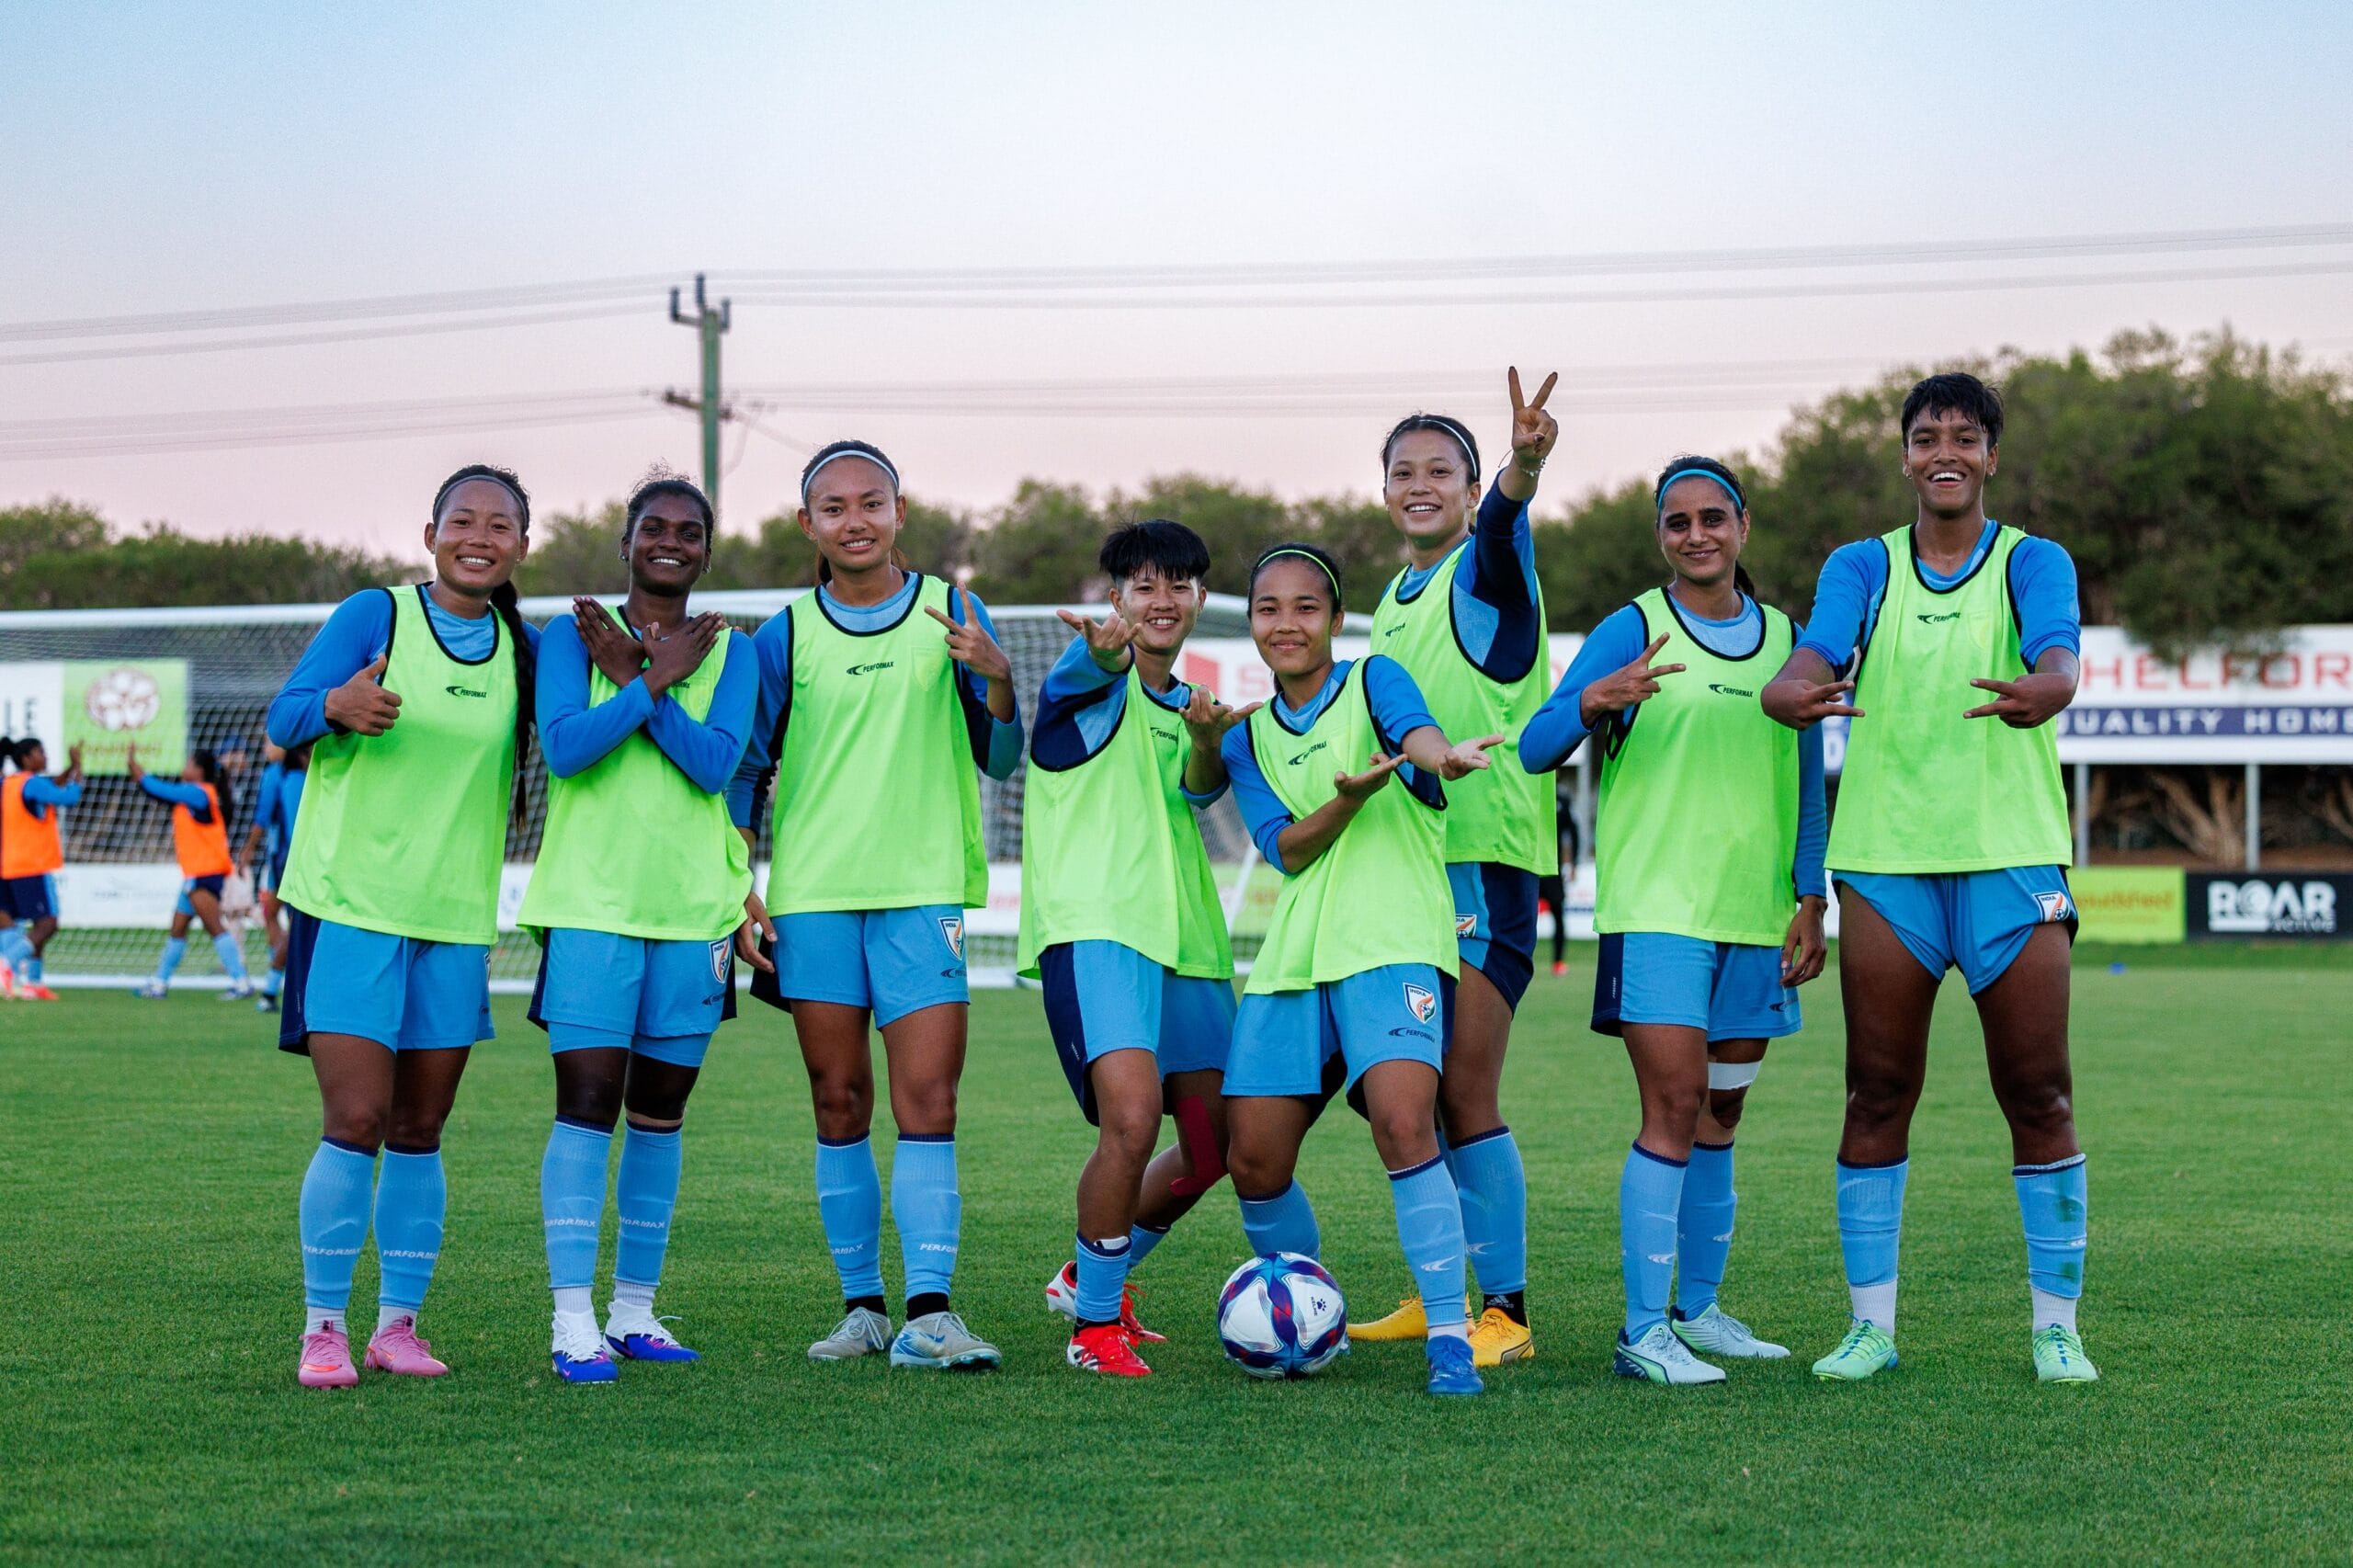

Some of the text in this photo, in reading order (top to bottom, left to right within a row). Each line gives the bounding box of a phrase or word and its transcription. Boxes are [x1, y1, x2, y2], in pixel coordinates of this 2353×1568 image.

[863, 661, 894, 673] PERFORMAX
[2082, 651, 2353, 690] HELFOR
[460, 688, 487, 699] PERFORMAX
[1722, 687, 1754, 698] PERFORMAX
[3, 696, 40, 738] LE
[2208, 880, 2336, 922] ROAR
[1409, 987, 1427, 997] INDIA
